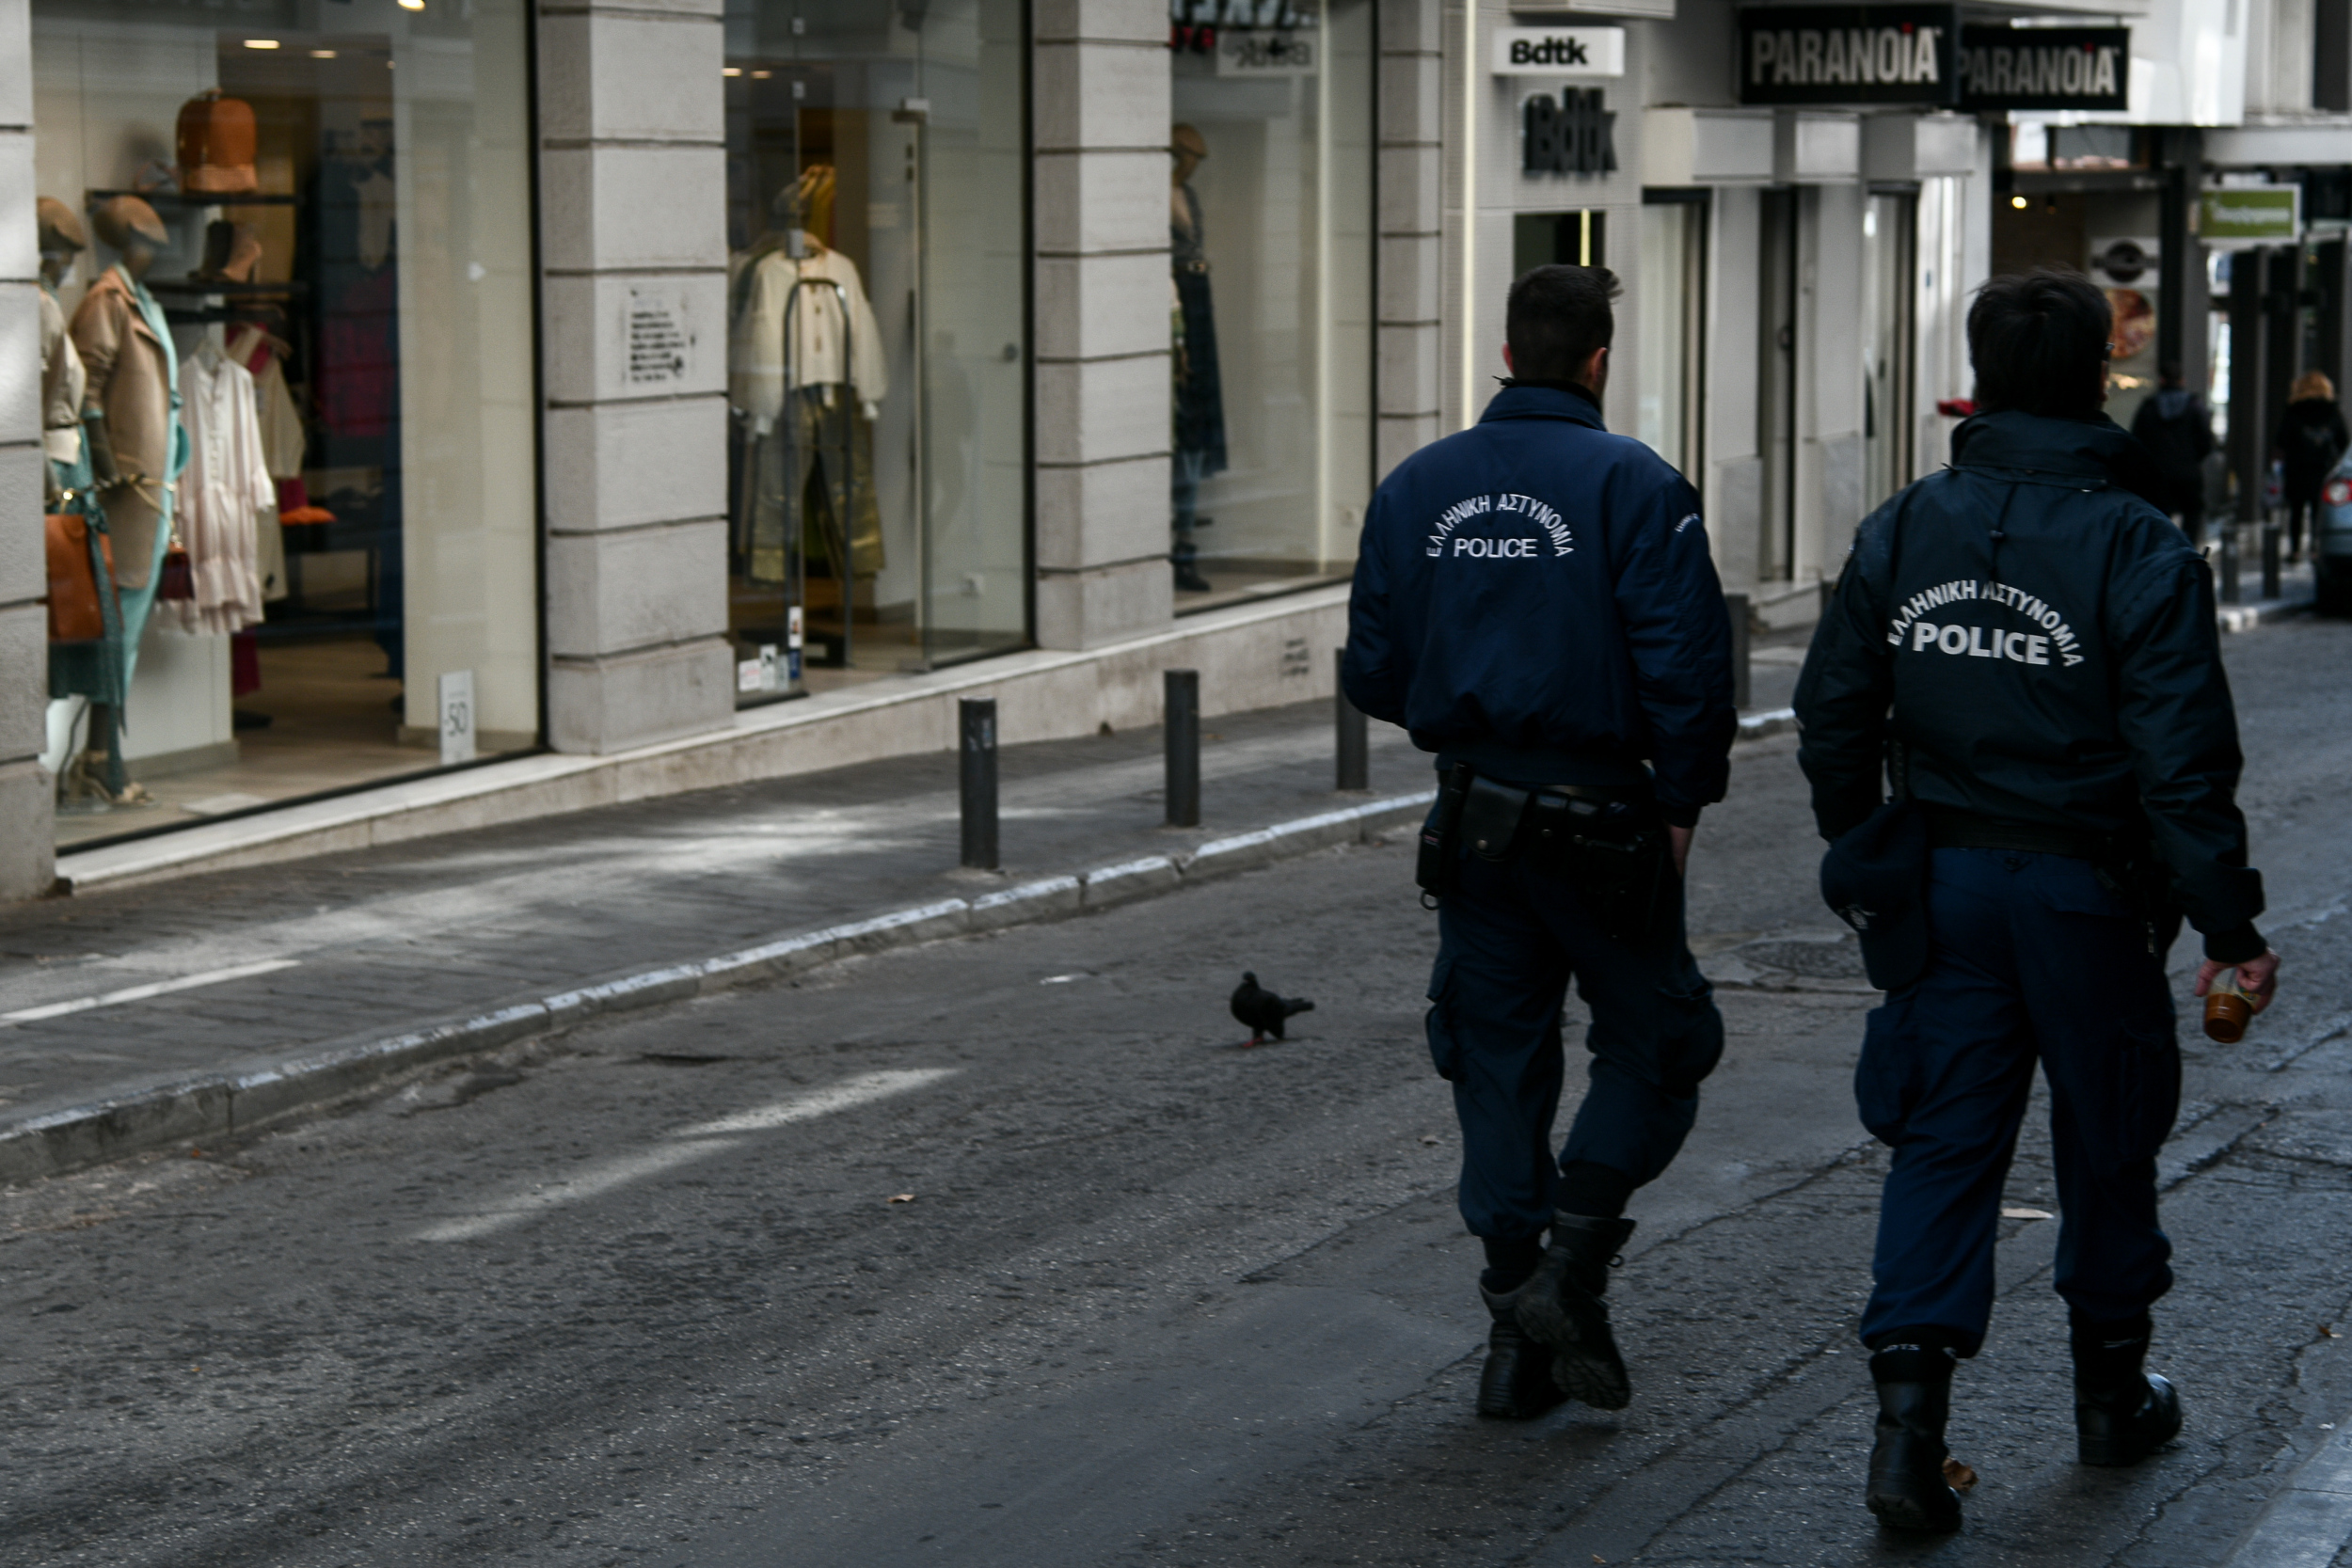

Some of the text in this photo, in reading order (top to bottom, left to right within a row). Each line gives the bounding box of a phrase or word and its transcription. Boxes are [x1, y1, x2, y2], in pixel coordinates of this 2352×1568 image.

[1510, 36, 1588, 65] Bdtk
[1523, 86, 1619, 173] Bdtk
[1425, 493, 1575, 558] ΕΛΛΗΝΙΚΗ ΑΣΤΥΝΟΜΙΑ
[1454, 538, 1538, 558] POLICE
[1885, 579, 2086, 668] ΕΛΛΗΝΙΚΗ ΑΣΤΥΝΟΜΙΑ
[1912, 622, 2050, 666] POLICE
